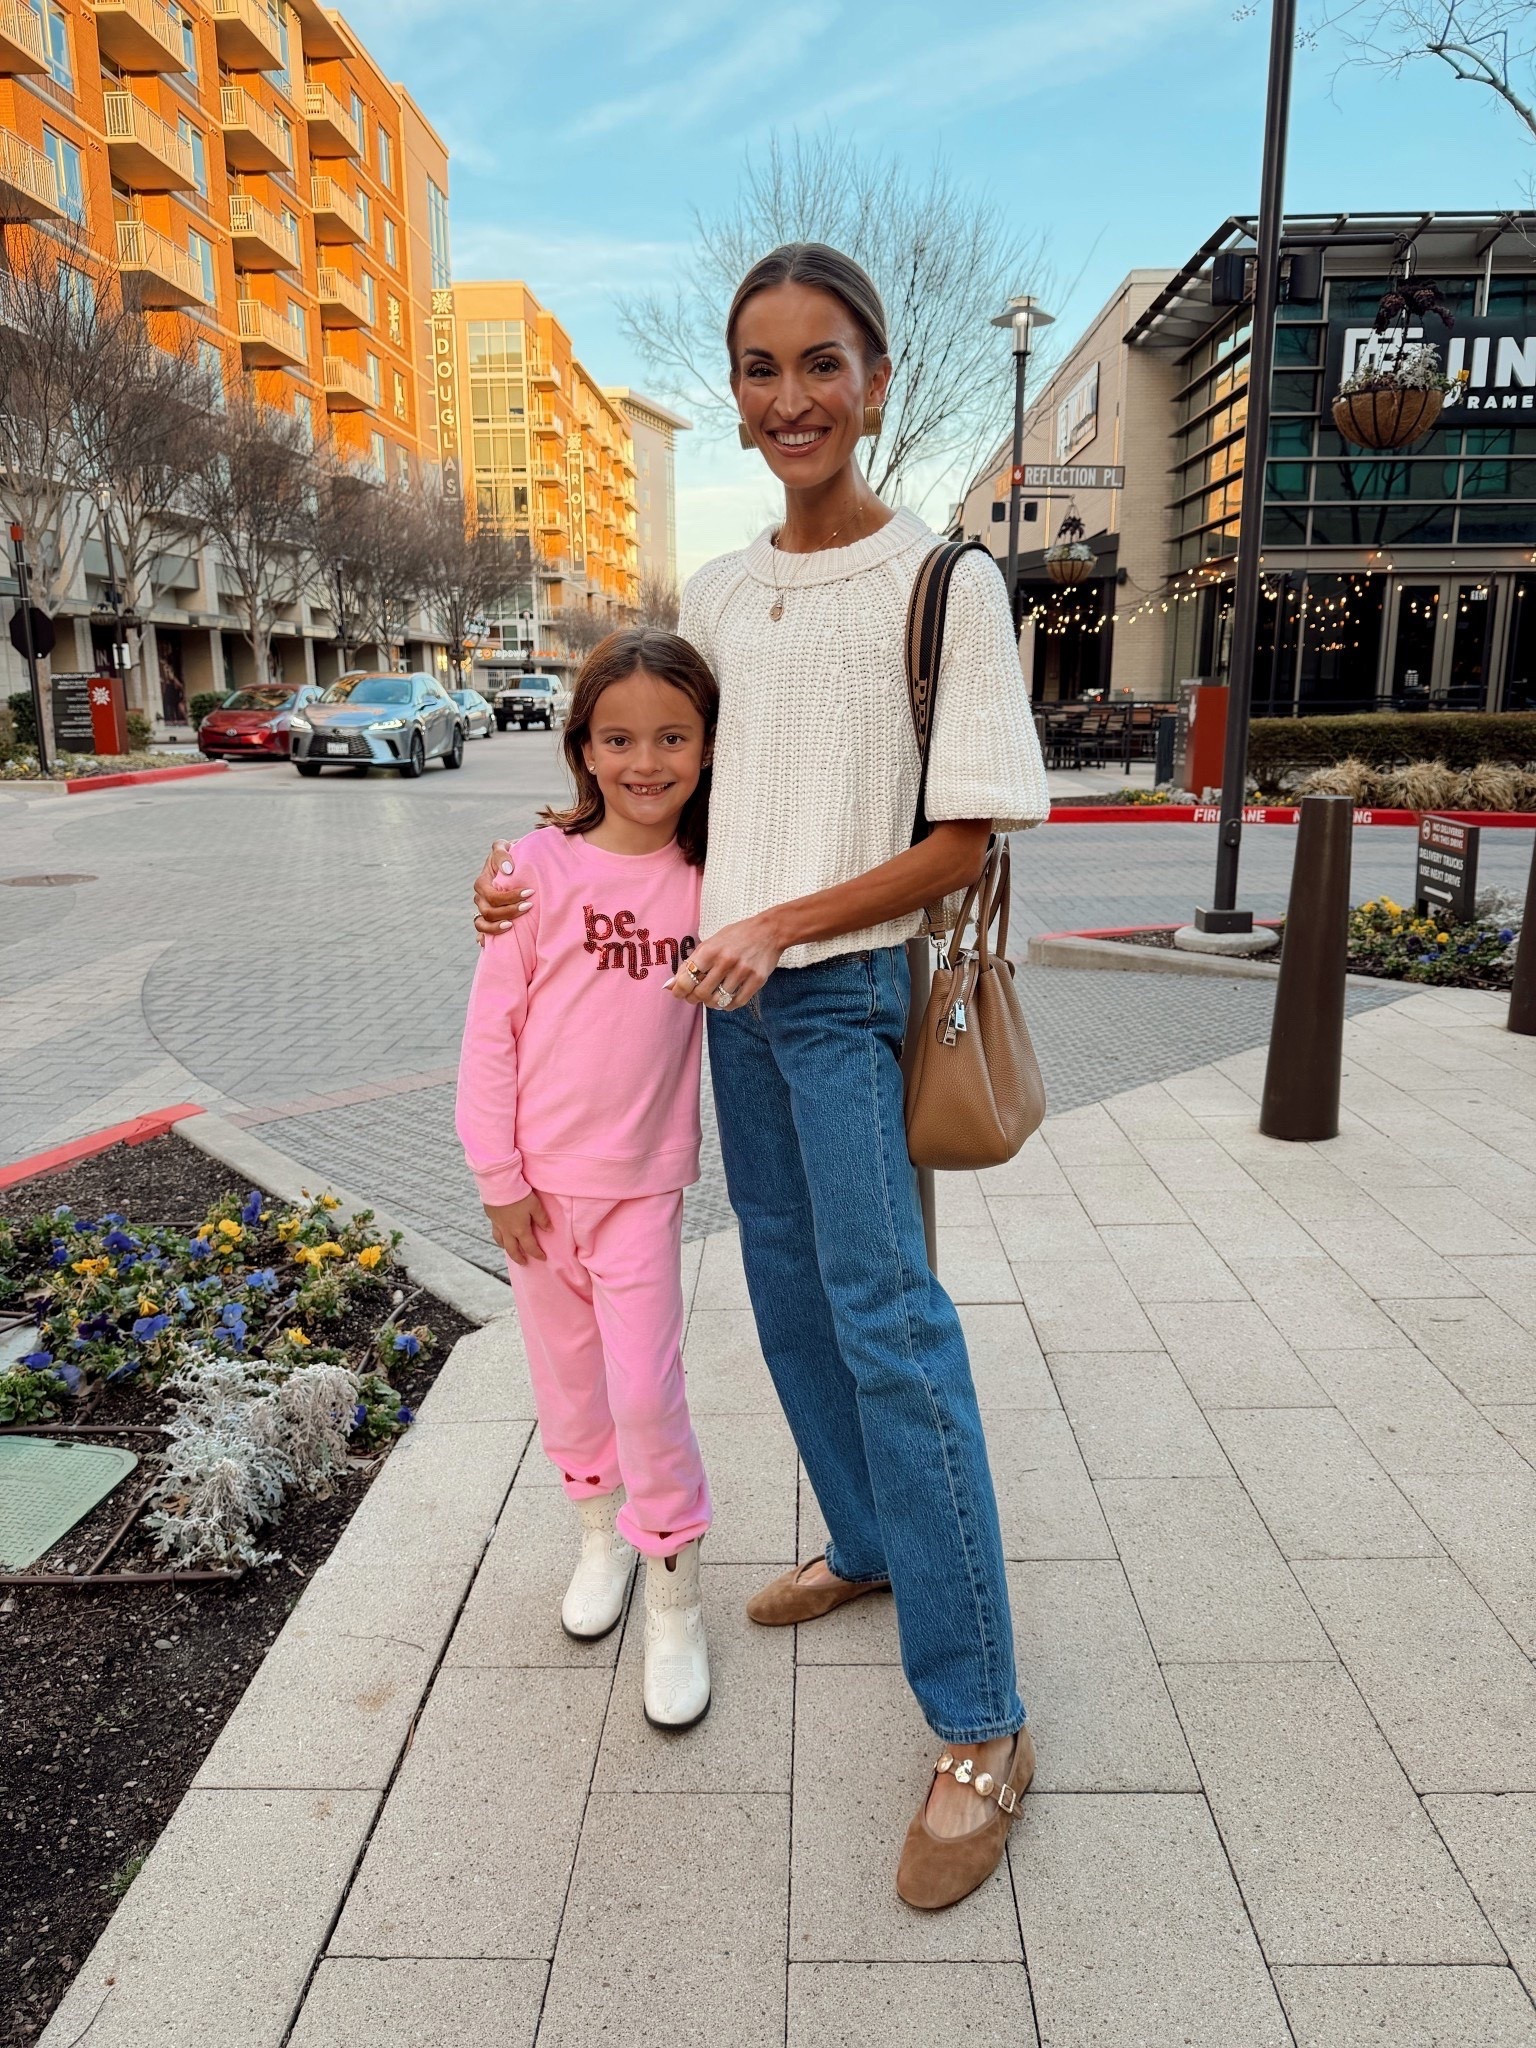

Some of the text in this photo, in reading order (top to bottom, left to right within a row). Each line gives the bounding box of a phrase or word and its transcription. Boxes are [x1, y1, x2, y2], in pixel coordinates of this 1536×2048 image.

[435, 321, 451, 331] THE
[436, 337, 457, 495] DOUGLAS
[1024, 467, 1097, 486] REFLECTION
[1103, 469, 1122, 487] PL.
[571, 473, 582, 562] ROYAL
[1440, 824, 1464, 839] DELIVERIES
[1450, 838, 1463, 849] DRIVE
[1419, 847, 1464, 871] DELIVERY TRUCKS
[1419, 864, 1461, 888] USE NEXT DRIVE
[582, 903, 636, 941] be
[583, 928, 696, 981] mine
